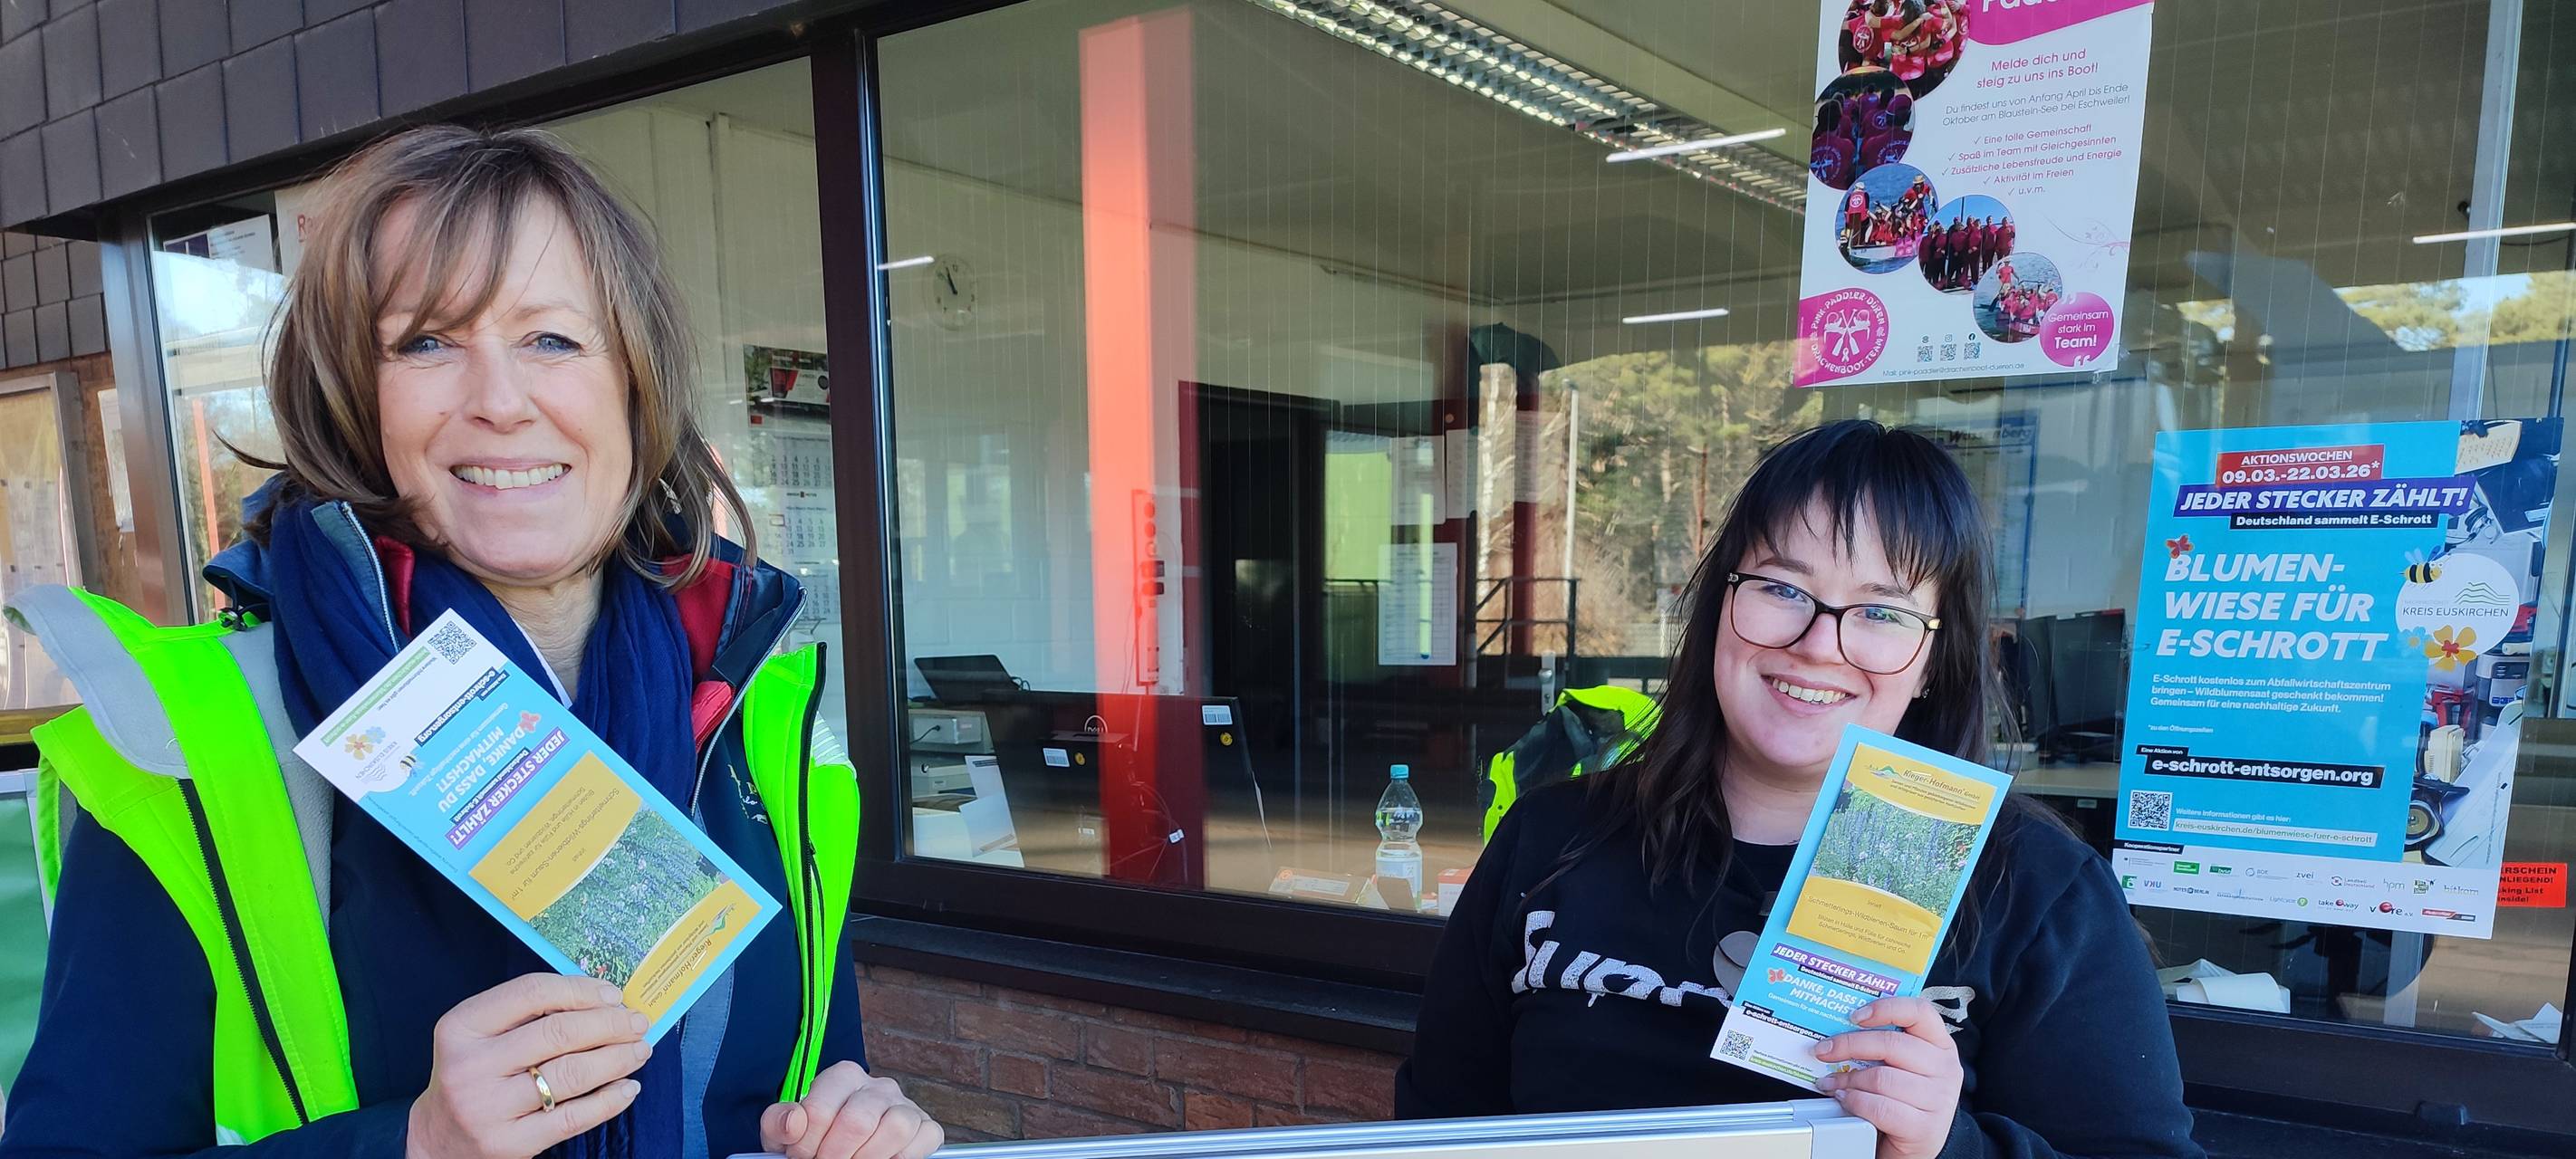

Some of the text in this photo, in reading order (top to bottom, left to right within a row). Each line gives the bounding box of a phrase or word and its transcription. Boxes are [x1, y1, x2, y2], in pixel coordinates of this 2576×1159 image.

[1991, 48, 2085, 70] Melde dich und
[1976, 62, 2098, 89] steig zu uns ins Boot!
[1942, 114, 1978, 126] Oktober
[1998, 104, 2058, 119] Blaustein-See
[2061, 101, 2075, 110] bei
[2078, 95, 2129, 109] Eschweiler!
[1946, 82, 2129, 113] Du findest uns von Anfang April bis Ende
[1984, 124, 2091, 144] Eine tolle Gemeinschaft
[1950, 148, 2121, 175] Zusätzliche Lebensfreude und Energie
[1958, 135, 2116, 162] Spaß im Team mit Gleichgesinnten
[1994, 167, 2073, 183] Aktivität im Freien
[2018, 185, 2045, 195] u.v.m.
[1823, 290, 1866, 309] PADDLER
[2047, 309, 2108, 323] Gemeinsam
[2058, 322, 2096, 333] stark im
[2053, 334, 2097, 349] Team!
[2241, 450, 2353, 465] AKTIONSWOCHEN
[2180, 481, 2469, 511] JEDER STECKER ZÄHLT!
[2235, 512, 2433, 527] Deutschland sammelt E-Schrott
[2164, 552, 2346, 582] BLUMEN-
[2163, 583, 2376, 622] WIESE FÜR
[2402, 607, 2509, 617] KREIS EUSKIRCHEN
[2155, 628, 2389, 662] E-SCHROTT
[2151, 685, 2384, 703] bringen Wildblumensaat geschenkt bekommen!
[2152, 674, 2391, 691] E-Schrott kostenlos zum Abfallwirtschaftszentrum
[415, 667, 497, 744] e-schrott-entsorgen.org
[2150, 697, 2341, 713] Gemeinsam für eine nachhaltige Zukunft.
[433, 724, 505, 793] MITMACHST!
[434, 723, 527, 813] DANKE, DASS DU
[2151, 757, 2375, 785] e-schrott-entsorgen.org
[447, 729, 567, 848] JEDER STECKER ZÄHLT!
[2176, 808, 2201, 816] Weitere
[2202, 809, 2250, 819] Informationen
[2251, 812, 2264, 821] gibt
[2275, 814, 2291, 822] hier:
[527, 786, 620, 879] Schmetterlings-Wildbienen-Saum
[2501, 867, 2557, 875] RSCHEIN
[1773, 944, 1898, 993] JEDER STECKER ZÄHLT!
[1782, 972, 1868, 1009] DANKE, DASS D
[1789, 987, 1856, 1017] MITMACHST
